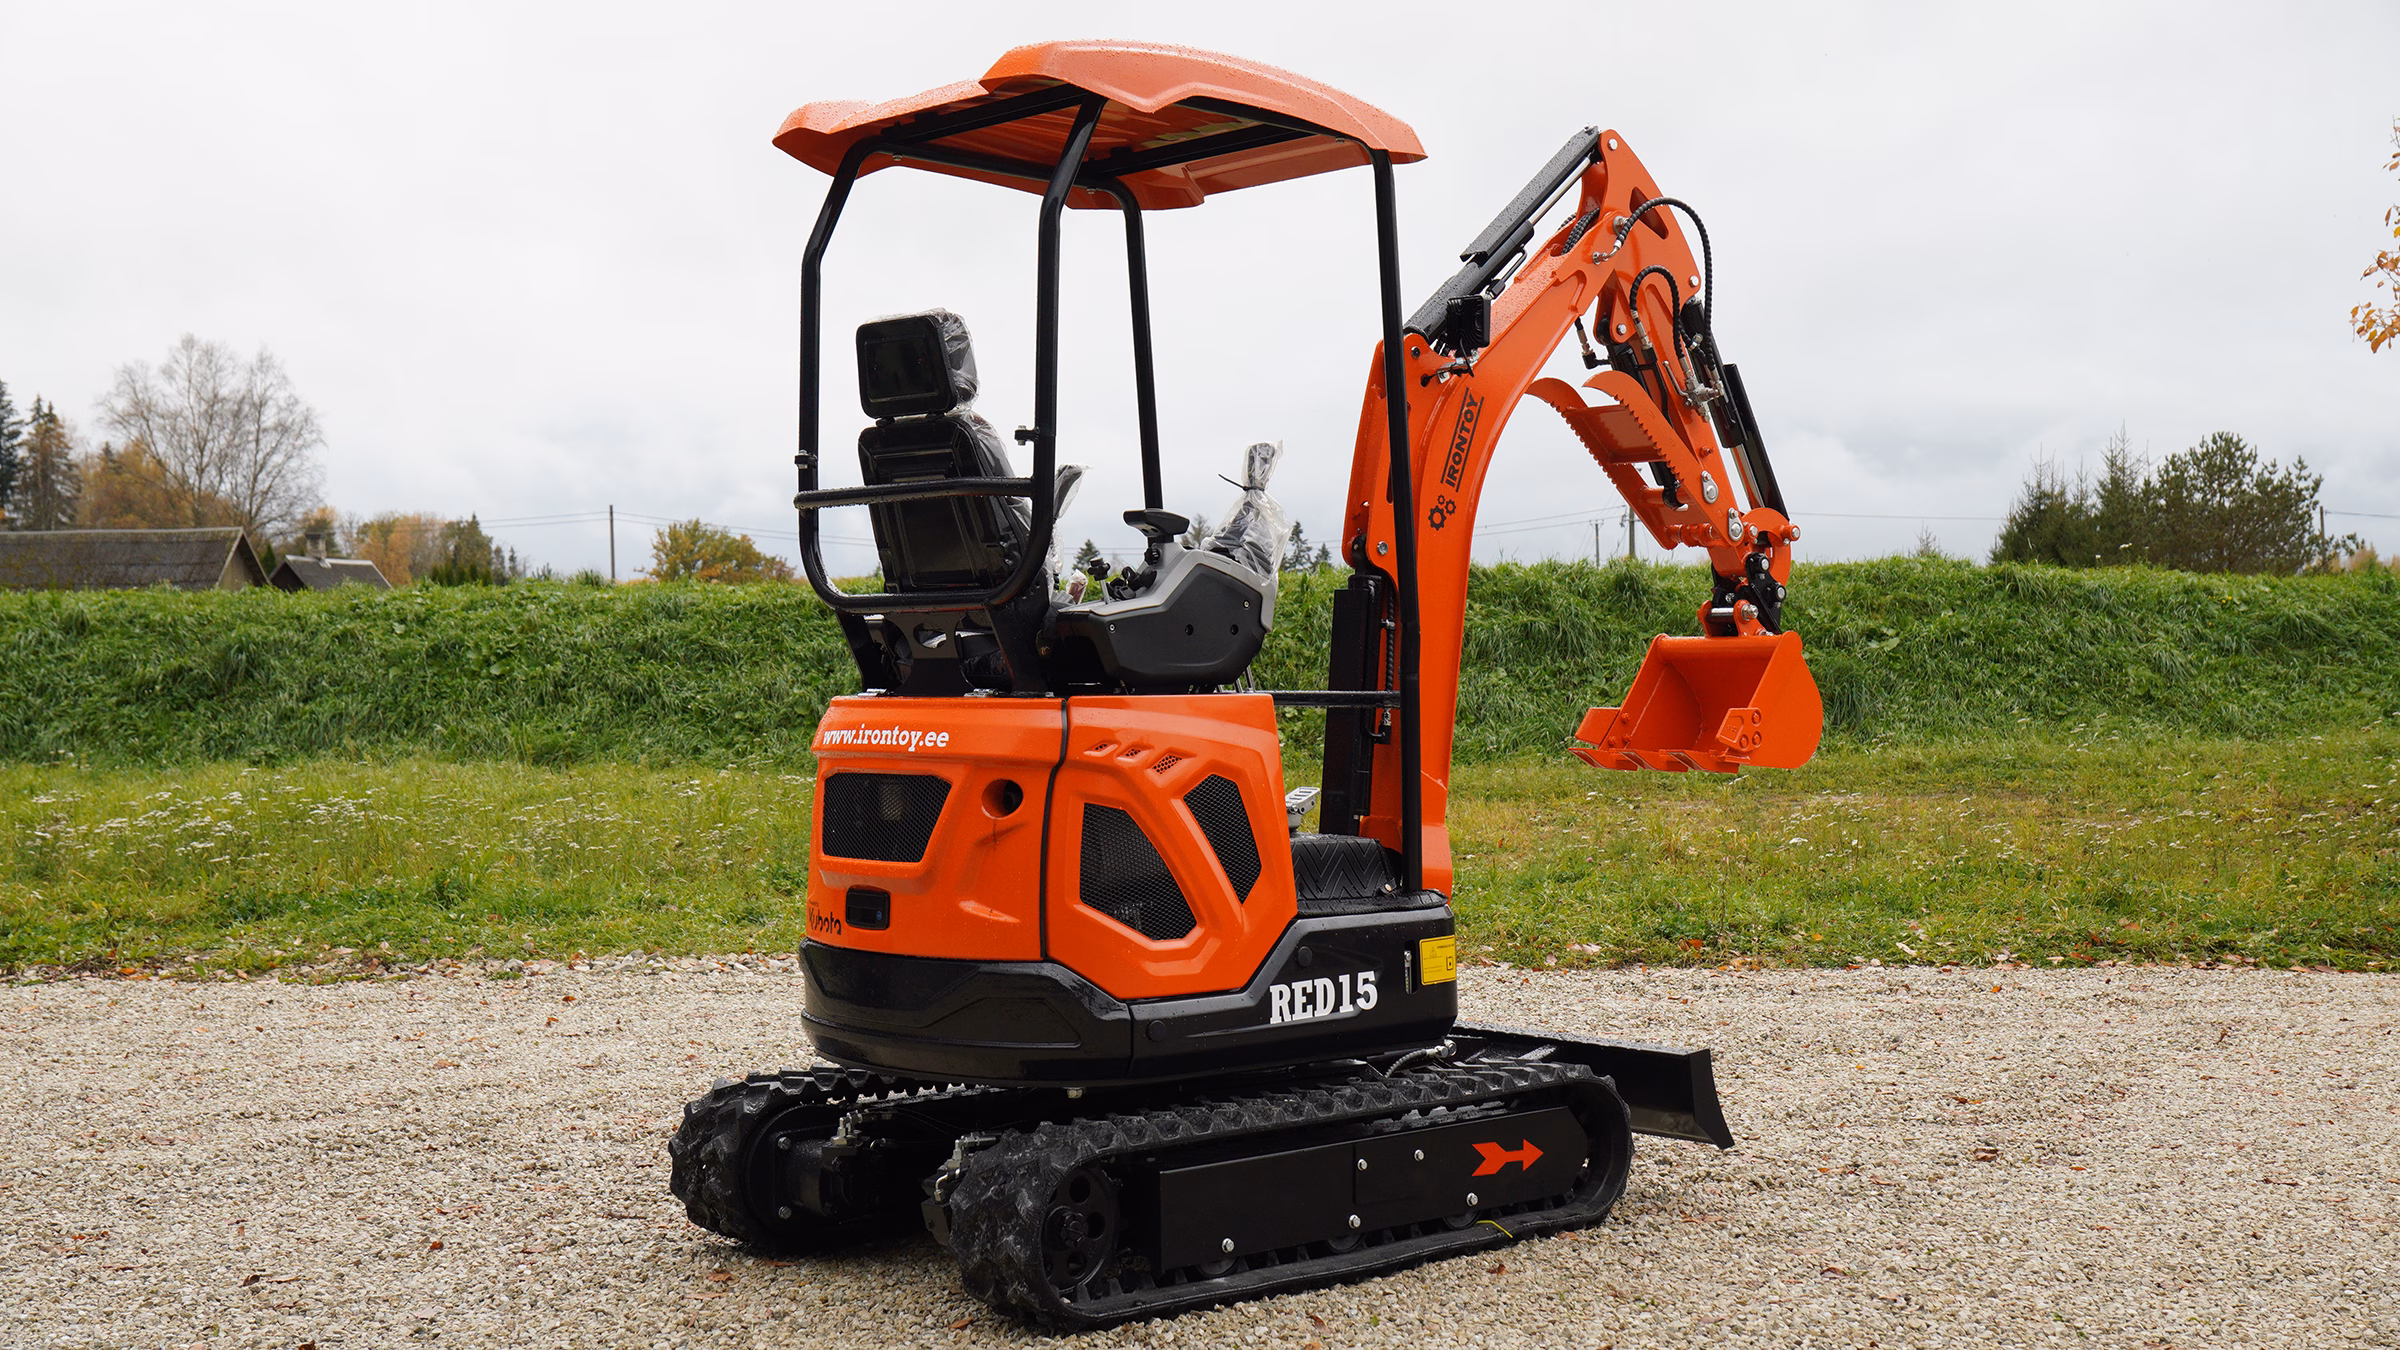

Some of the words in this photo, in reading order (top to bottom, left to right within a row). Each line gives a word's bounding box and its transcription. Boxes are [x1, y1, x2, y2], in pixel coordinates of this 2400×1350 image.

[1445, 393, 1478, 488] IRONTOY
[822, 723, 950, 752] www.irontoy.ee
[808, 907, 842, 935] Kubota
[1269, 970, 1378, 1024] RED15
